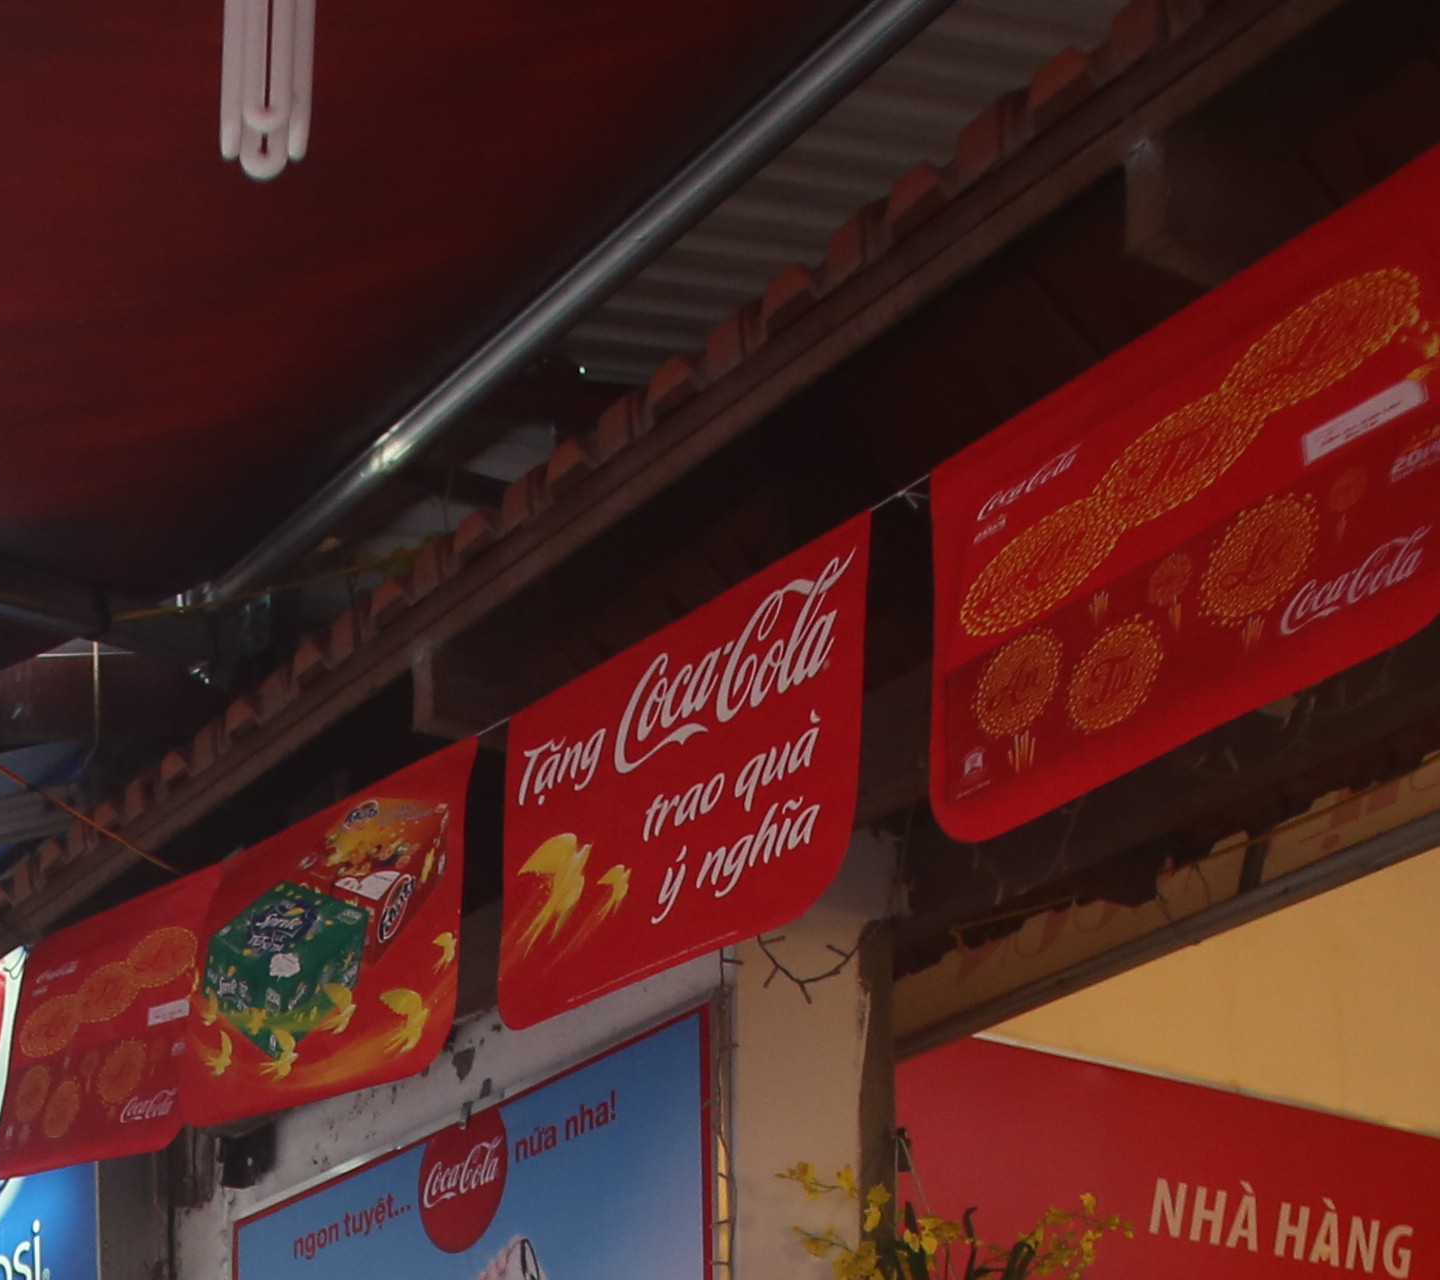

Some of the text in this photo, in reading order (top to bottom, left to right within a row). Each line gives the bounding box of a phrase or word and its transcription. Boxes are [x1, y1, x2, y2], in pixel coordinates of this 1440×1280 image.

[517, 545, 859, 806] Tặng Coca-Cola
[641, 712, 822, 843] trao quà
[651, 803, 823, 926] ý nghĩa
[292, 1226, 341, 1262] ngon
[421, 1134, 504, 1212] Coca-Cola
[515, 1124, 560, 1164] nữa
[563, 1090, 619, 1148] nha!
[1149, 1176, 1261, 1252] NHÀ
